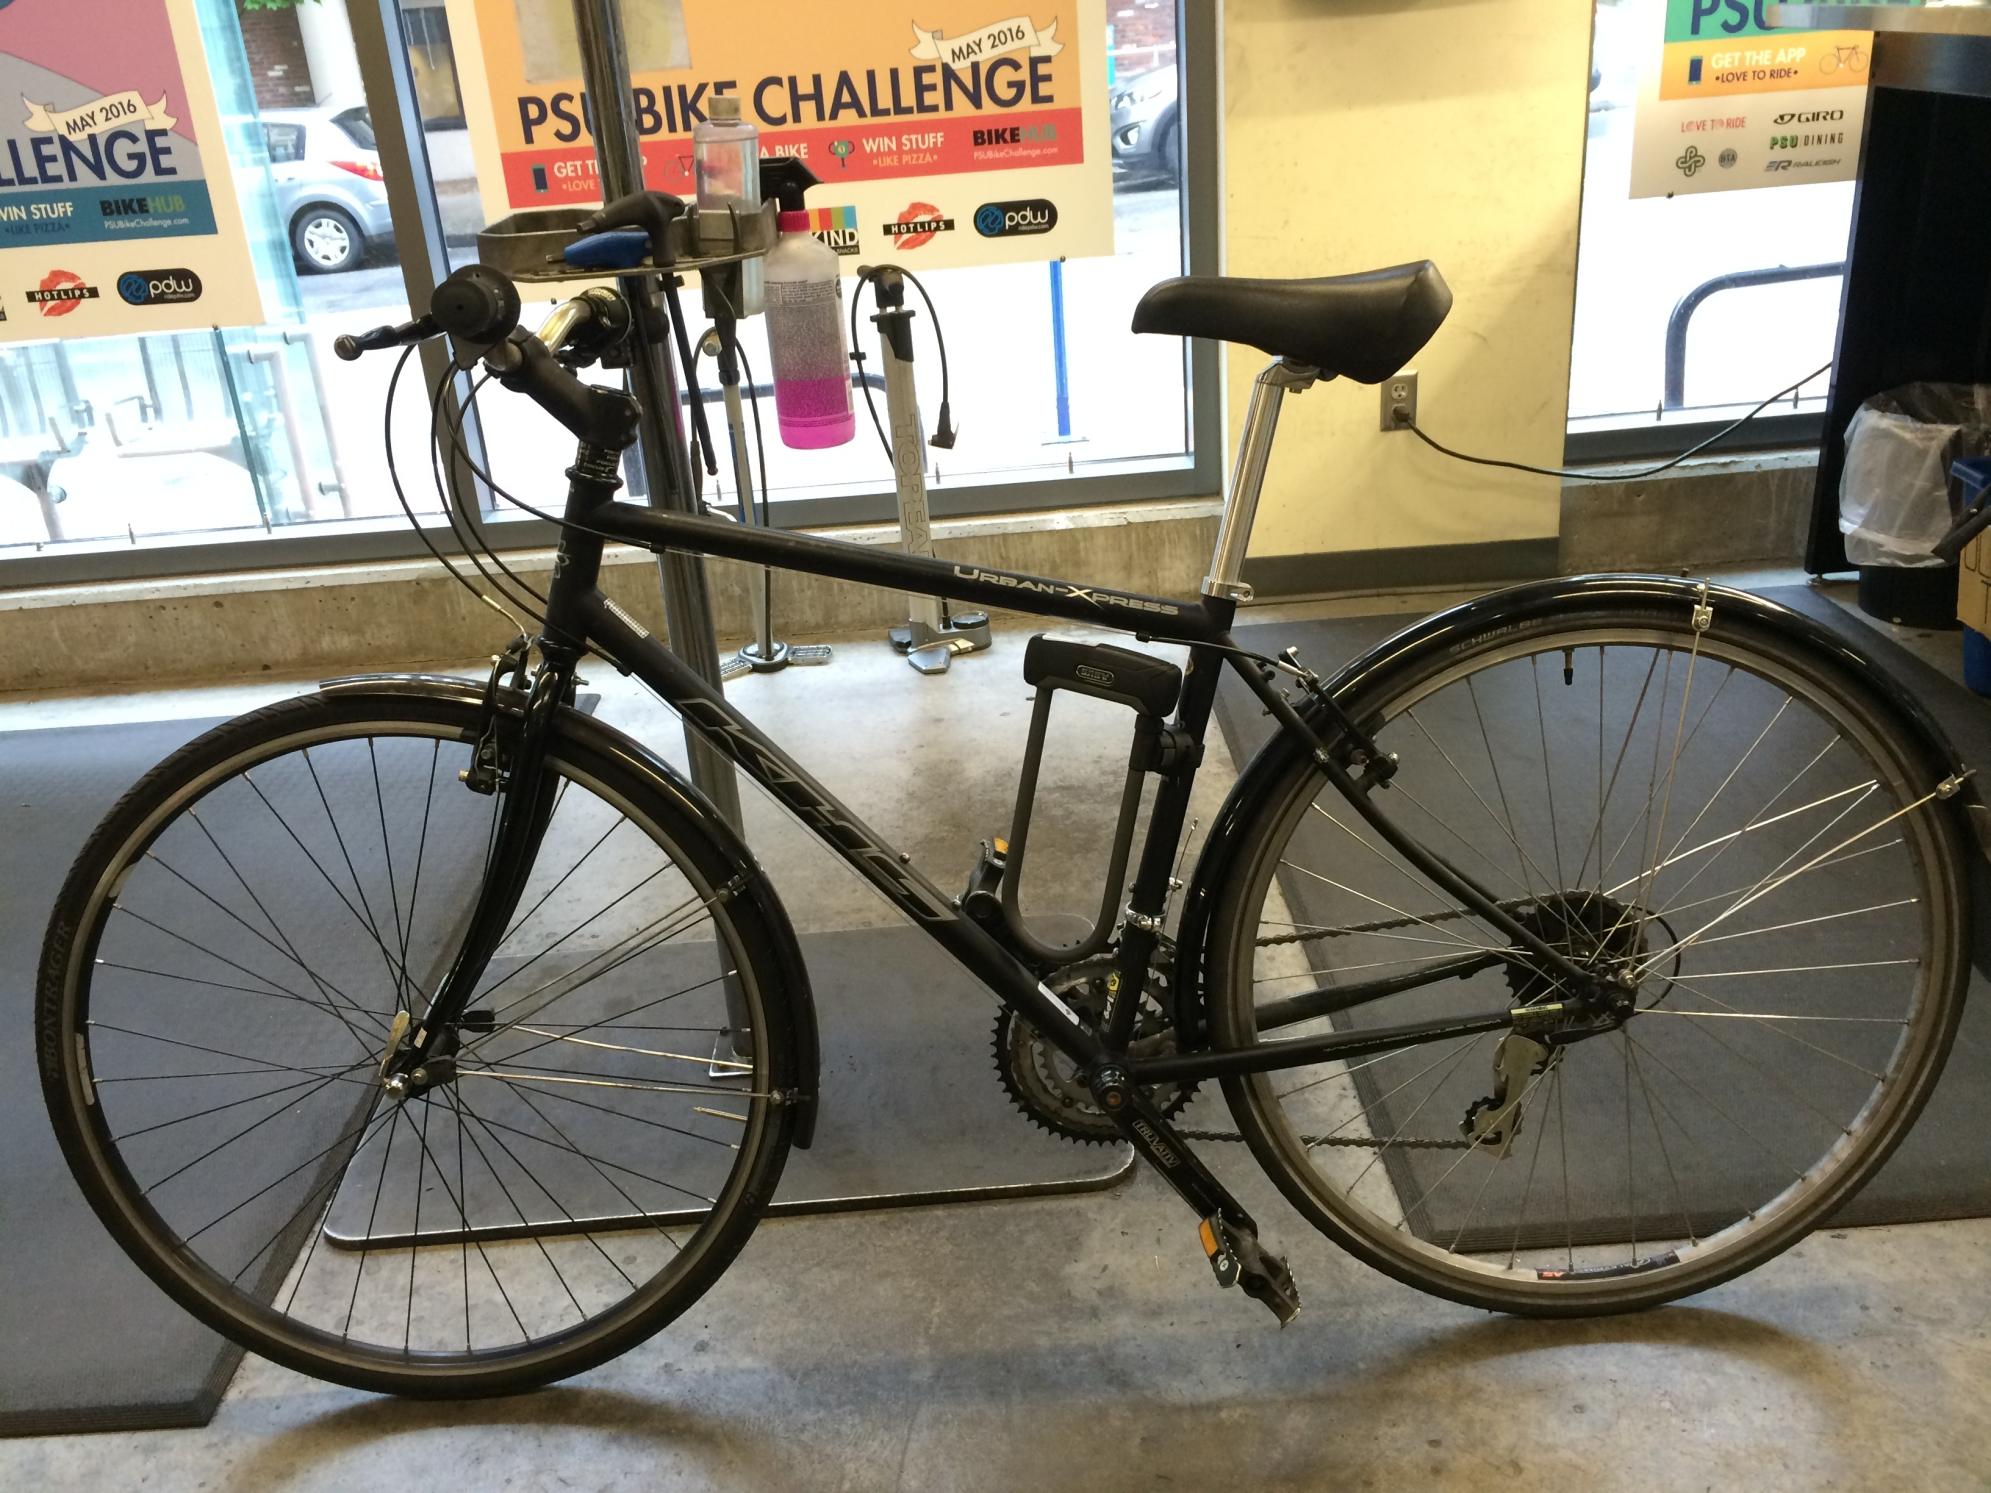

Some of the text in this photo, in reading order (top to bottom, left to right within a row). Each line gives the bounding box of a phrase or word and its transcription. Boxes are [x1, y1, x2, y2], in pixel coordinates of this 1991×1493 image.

[951, 25, 1026, 64] MAY 2016
[1712, 47, 1807, 69] GET THE APP
[1720, 68, 1793, 83] LOVE TO RIDE
[753, 55, 1055, 127] CHALLENGE
[65, 99, 138, 136] MAY 2016
[1726, 116, 1747, 129] RIDE
[1797, 110, 1844, 123] GIRO
[862, 132, 944, 153] WIN STUFF
[1770, 132, 1844, 150] PSU DINING
[760, 143, 808, 158] A BIKE
[878, 152, 933, 167] LIKE PIZZA
[554, 161, 583, 178] GET
[567, 179, 595, 191] LOVE
[31, 202, 74, 220] STUFF
[1005, 206, 1049, 230] pdw
[104, 217, 189, 229] PSUBikeChallenge.com
[891, 221, 946, 234] HOTLIPS
[34, 290, 90, 301] HOTLIPS
[150, 276, 193, 299] pdw
